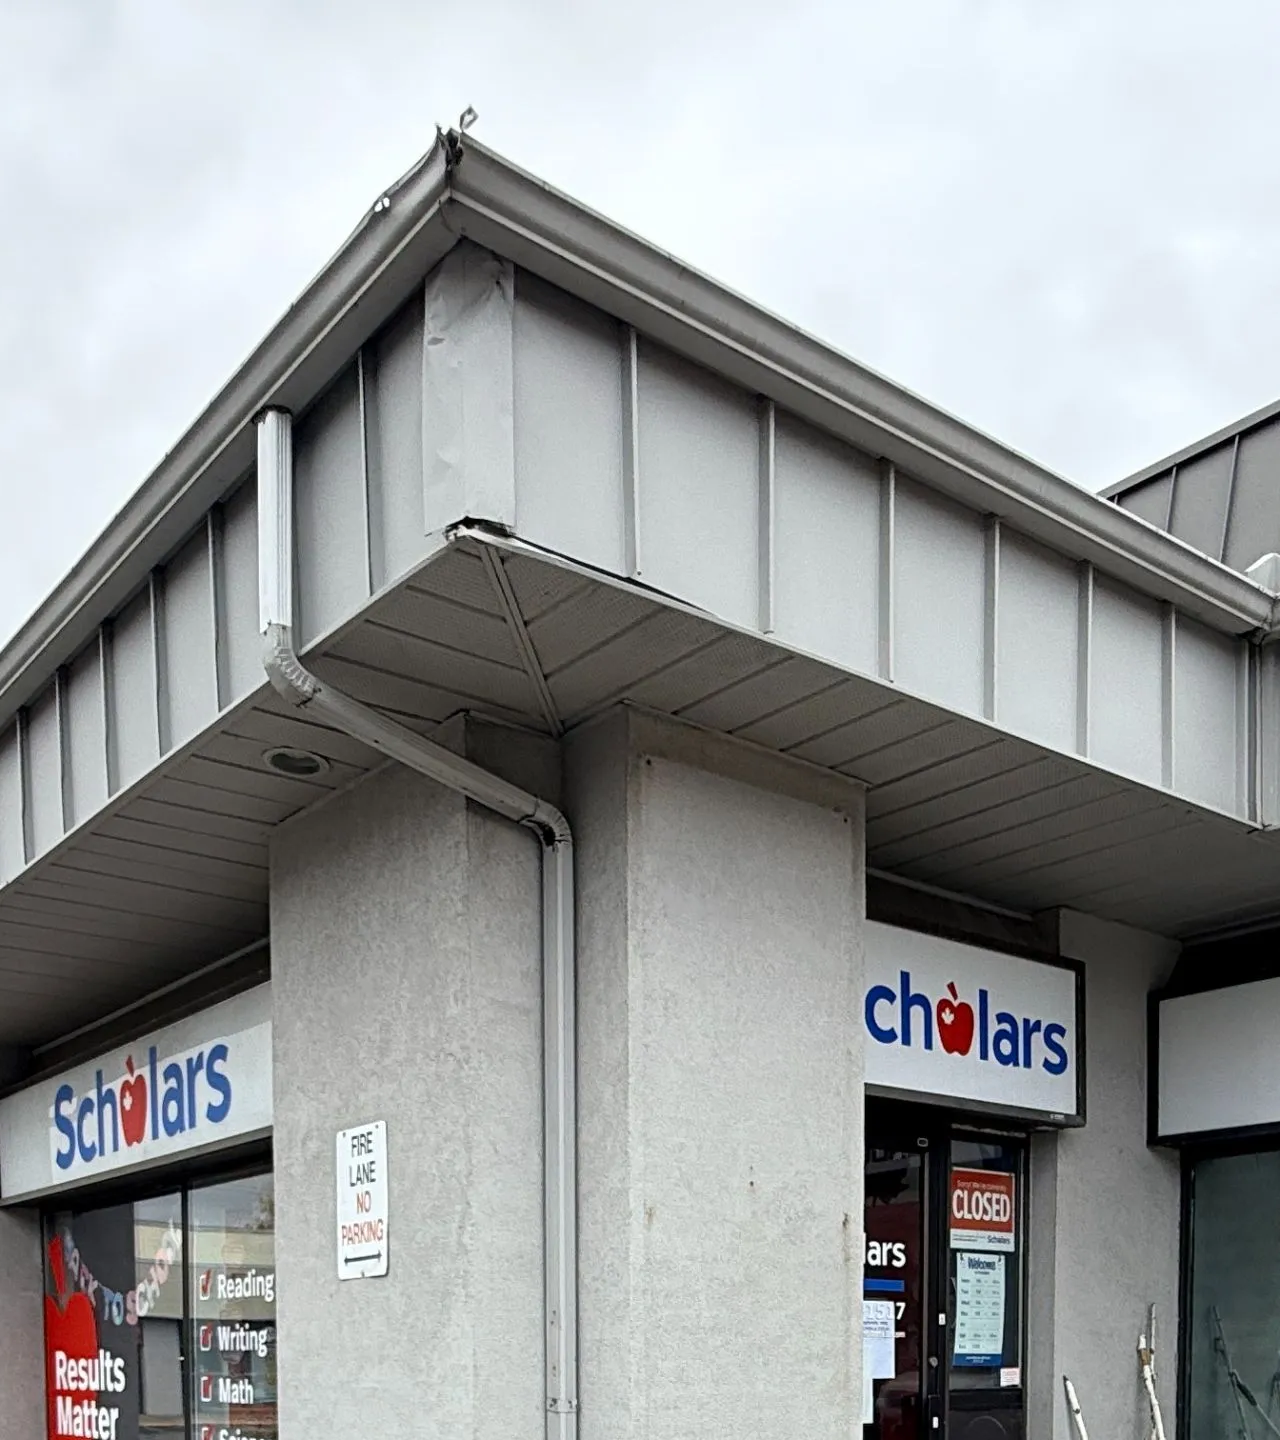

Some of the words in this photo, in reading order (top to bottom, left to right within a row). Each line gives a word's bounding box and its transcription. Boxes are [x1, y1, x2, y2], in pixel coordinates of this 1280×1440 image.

[864, 970, 1068, 1076] cholars
[53, 1043, 232, 1170] Scholars
[350, 1130, 374, 1157] FIRE
[348, 1160, 376, 1187] LANE
[356, 1192, 373, 1215] NO
[952, 1189, 1011, 1223] CLOSED
[341, 1218, 384, 1246] PARKING
[863, 1232, 907, 1268] lars
[217, 1269, 275, 1302] Reading
[217, 1323, 268, 1358] Writing
[54, 1350, 126, 1393] Results
[219, 1377, 254, 1404] Math
